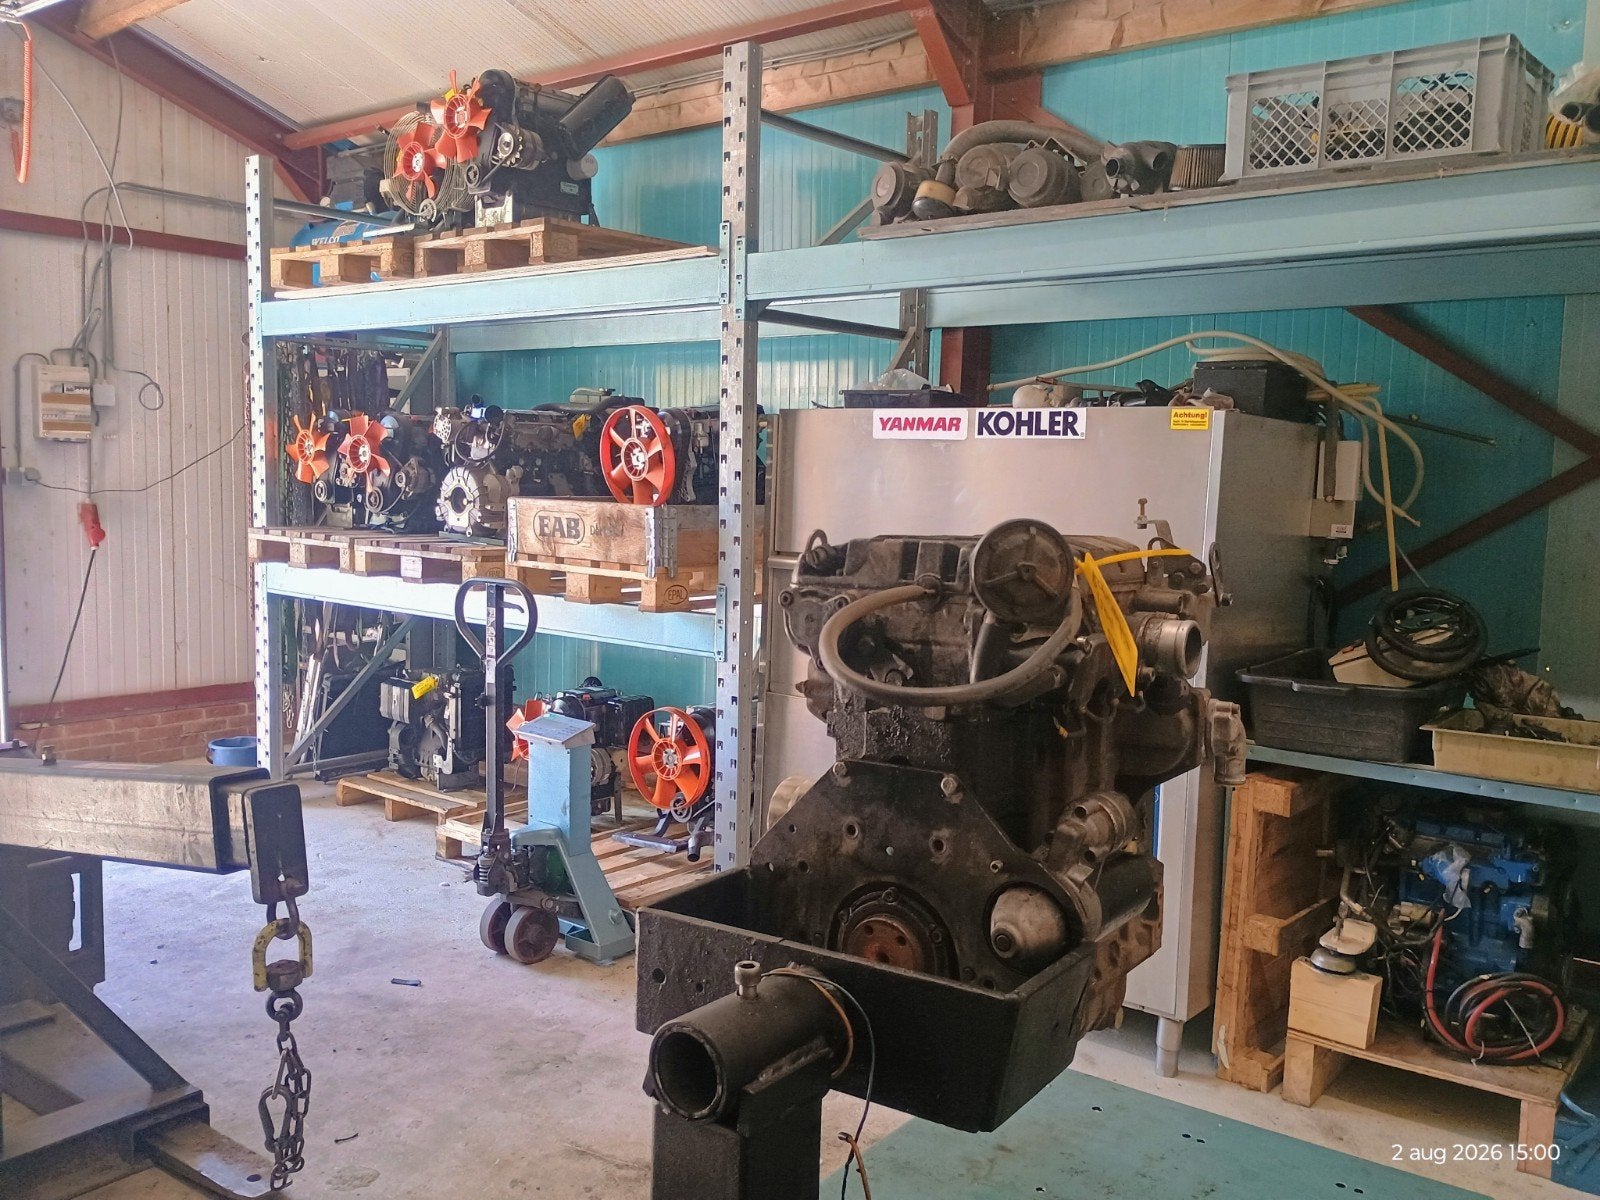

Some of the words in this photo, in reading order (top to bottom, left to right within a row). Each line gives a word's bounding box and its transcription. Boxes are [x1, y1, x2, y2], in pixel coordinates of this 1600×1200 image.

[977, 410, 1080, 436] KOHLER
[1173, 411, 1207, 419] Achtung!
[879, 416, 962, 432] YANMAR
[538, 515, 581, 540] EAB
[667, 588, 685, 601] EPAL
